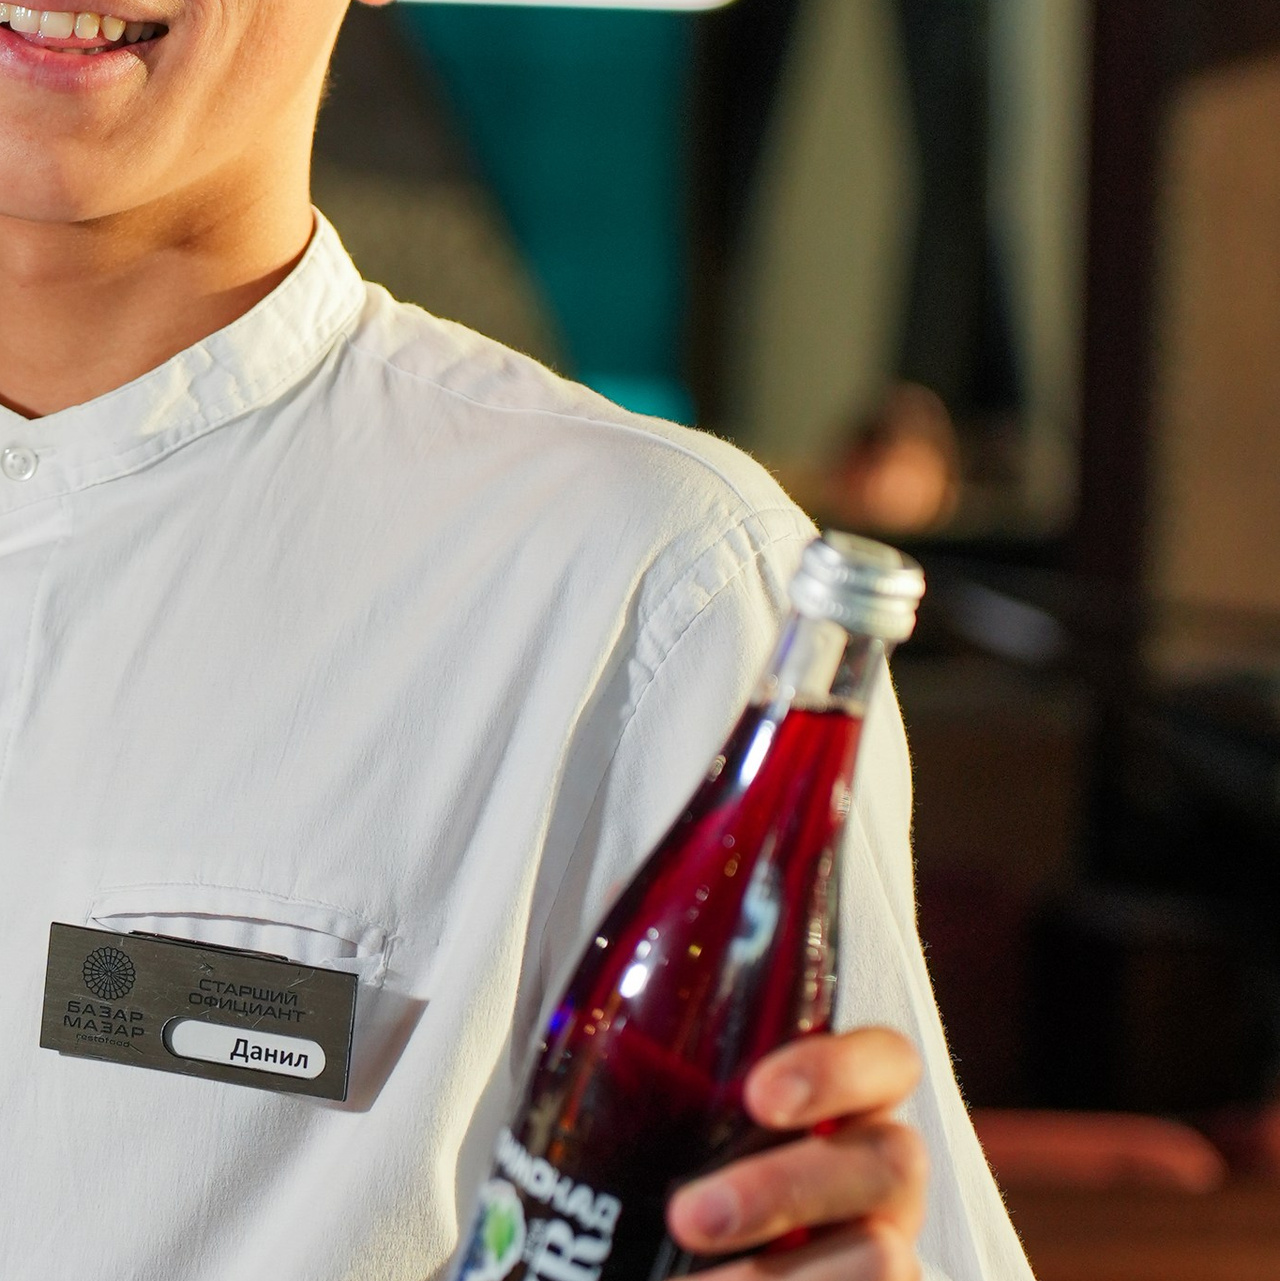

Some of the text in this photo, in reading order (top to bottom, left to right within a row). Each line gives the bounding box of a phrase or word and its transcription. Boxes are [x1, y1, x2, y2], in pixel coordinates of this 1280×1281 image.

[188, 992, 306, 1022] ОФИЦИАНТ
[199, 978, 298, 1007] СТАРШИЙ
[63, 1014, 145, 1038] МАЗАР
[67, 1000, 144, 1023] БАЗАР
[229, 1037, 310, 1070] Данил
